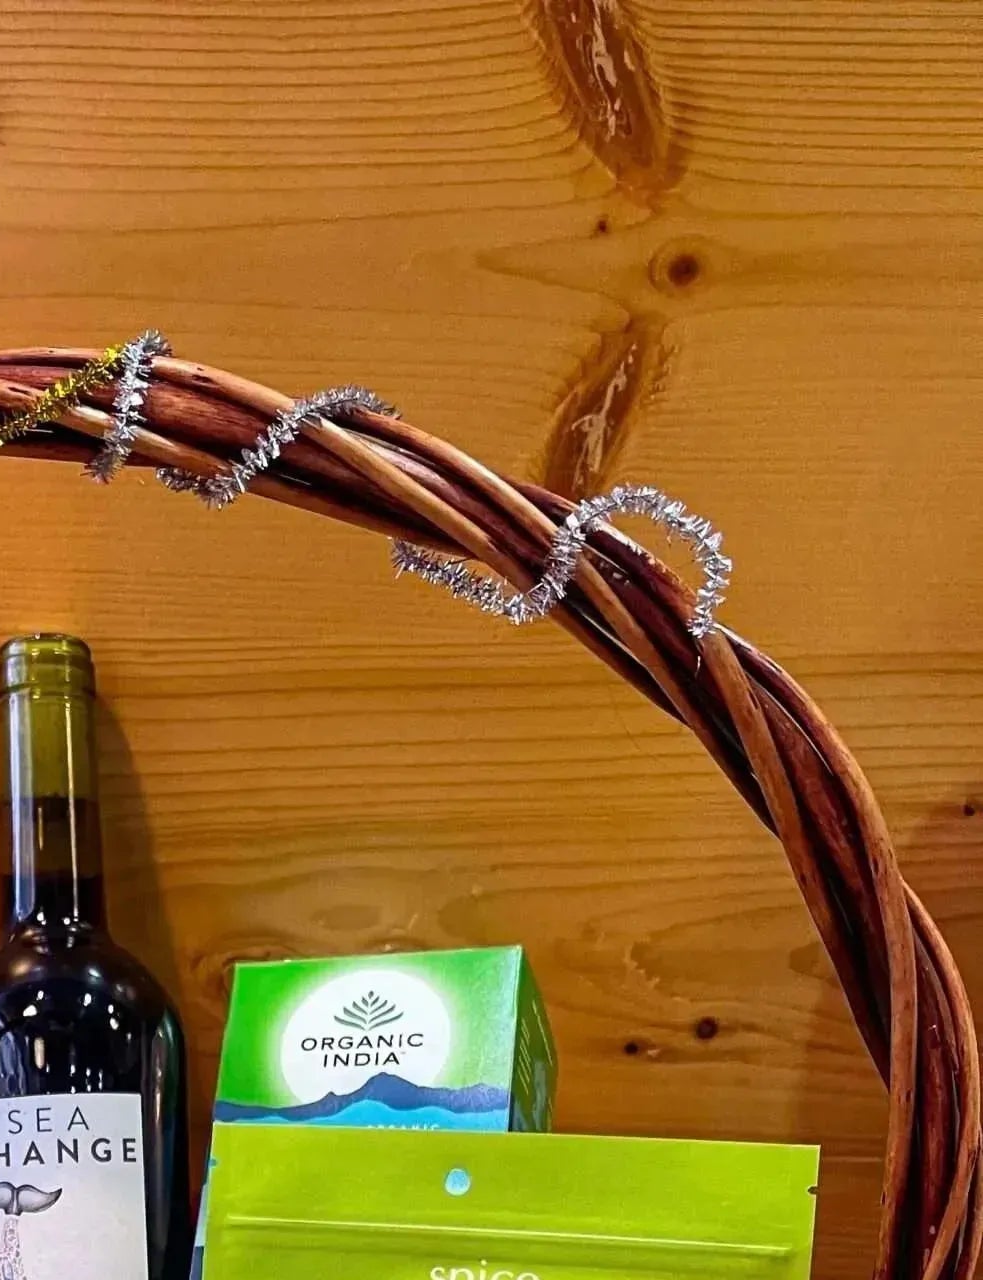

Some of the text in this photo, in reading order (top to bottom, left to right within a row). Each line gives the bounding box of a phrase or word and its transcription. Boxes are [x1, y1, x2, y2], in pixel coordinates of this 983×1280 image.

[301, 1033, 424, 1051] ORGANIC
[323, 1052, 400, 1068] INDIA
[8, 1106, 90, 1135] SEA
